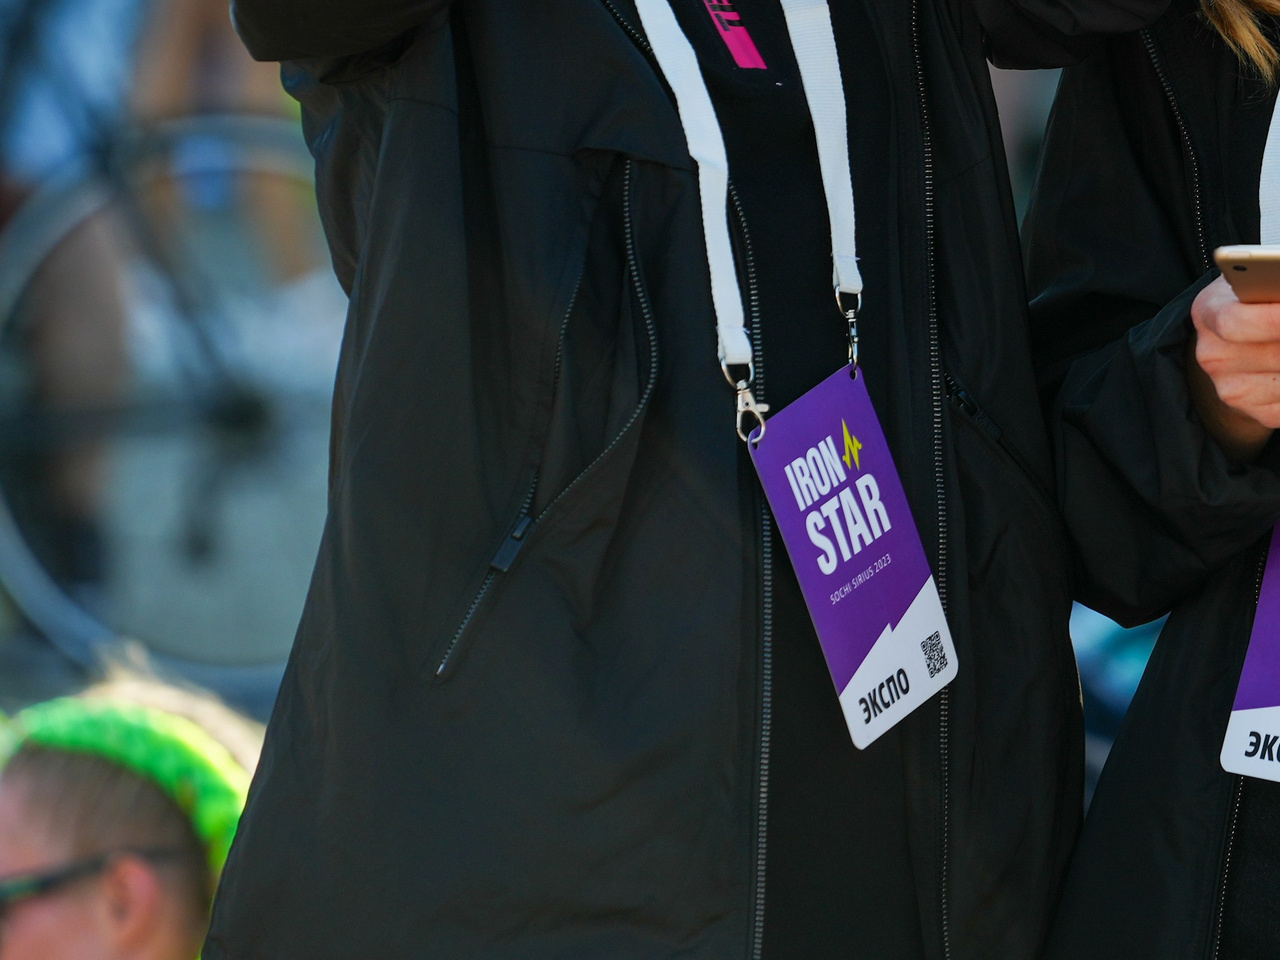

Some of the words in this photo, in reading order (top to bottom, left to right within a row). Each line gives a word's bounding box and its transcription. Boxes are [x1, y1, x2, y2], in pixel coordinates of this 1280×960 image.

[784, 435, 847, 512] IRON
[805, 473, 892, 576] STAR
[829, 582, 852, 605] SOCHI
[851, 565, 874, 589] SIRIUS
[873, 553, 892, 573] 2023
[858, 667, 910, 725] ЭКСПО
